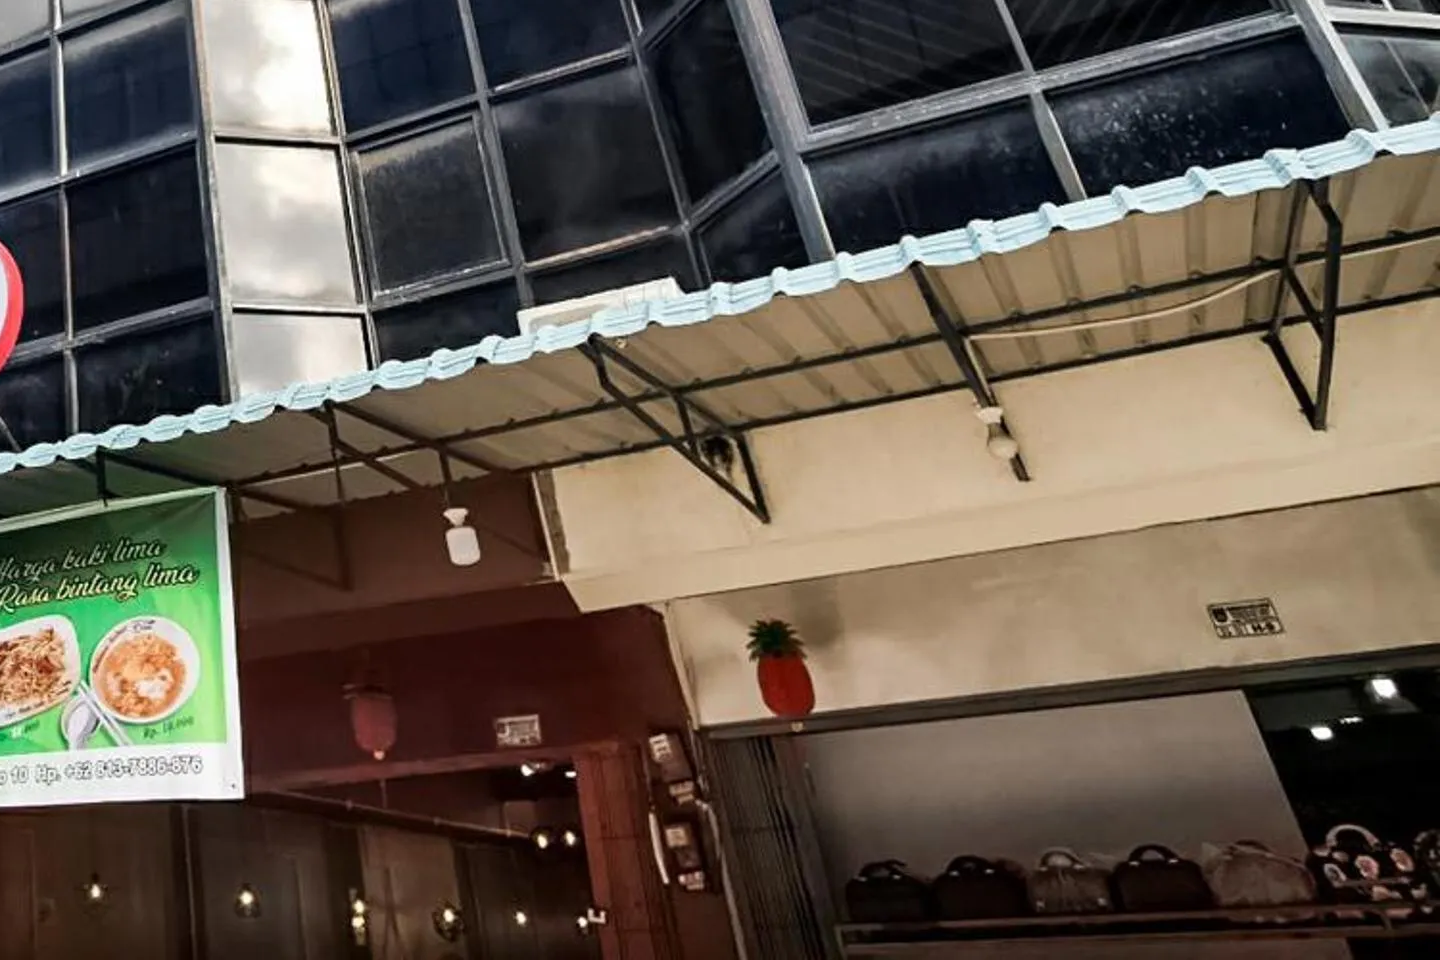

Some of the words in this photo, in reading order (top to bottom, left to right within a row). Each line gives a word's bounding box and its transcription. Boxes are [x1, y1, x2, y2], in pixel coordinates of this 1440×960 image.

[62, 544, 111, 570] kaki
[113, 539, 163, 562] lima
[57, 573, 139, 600] bintang
[143, 563, 197, 587] lima
[11, 765, 29, 783] 10
